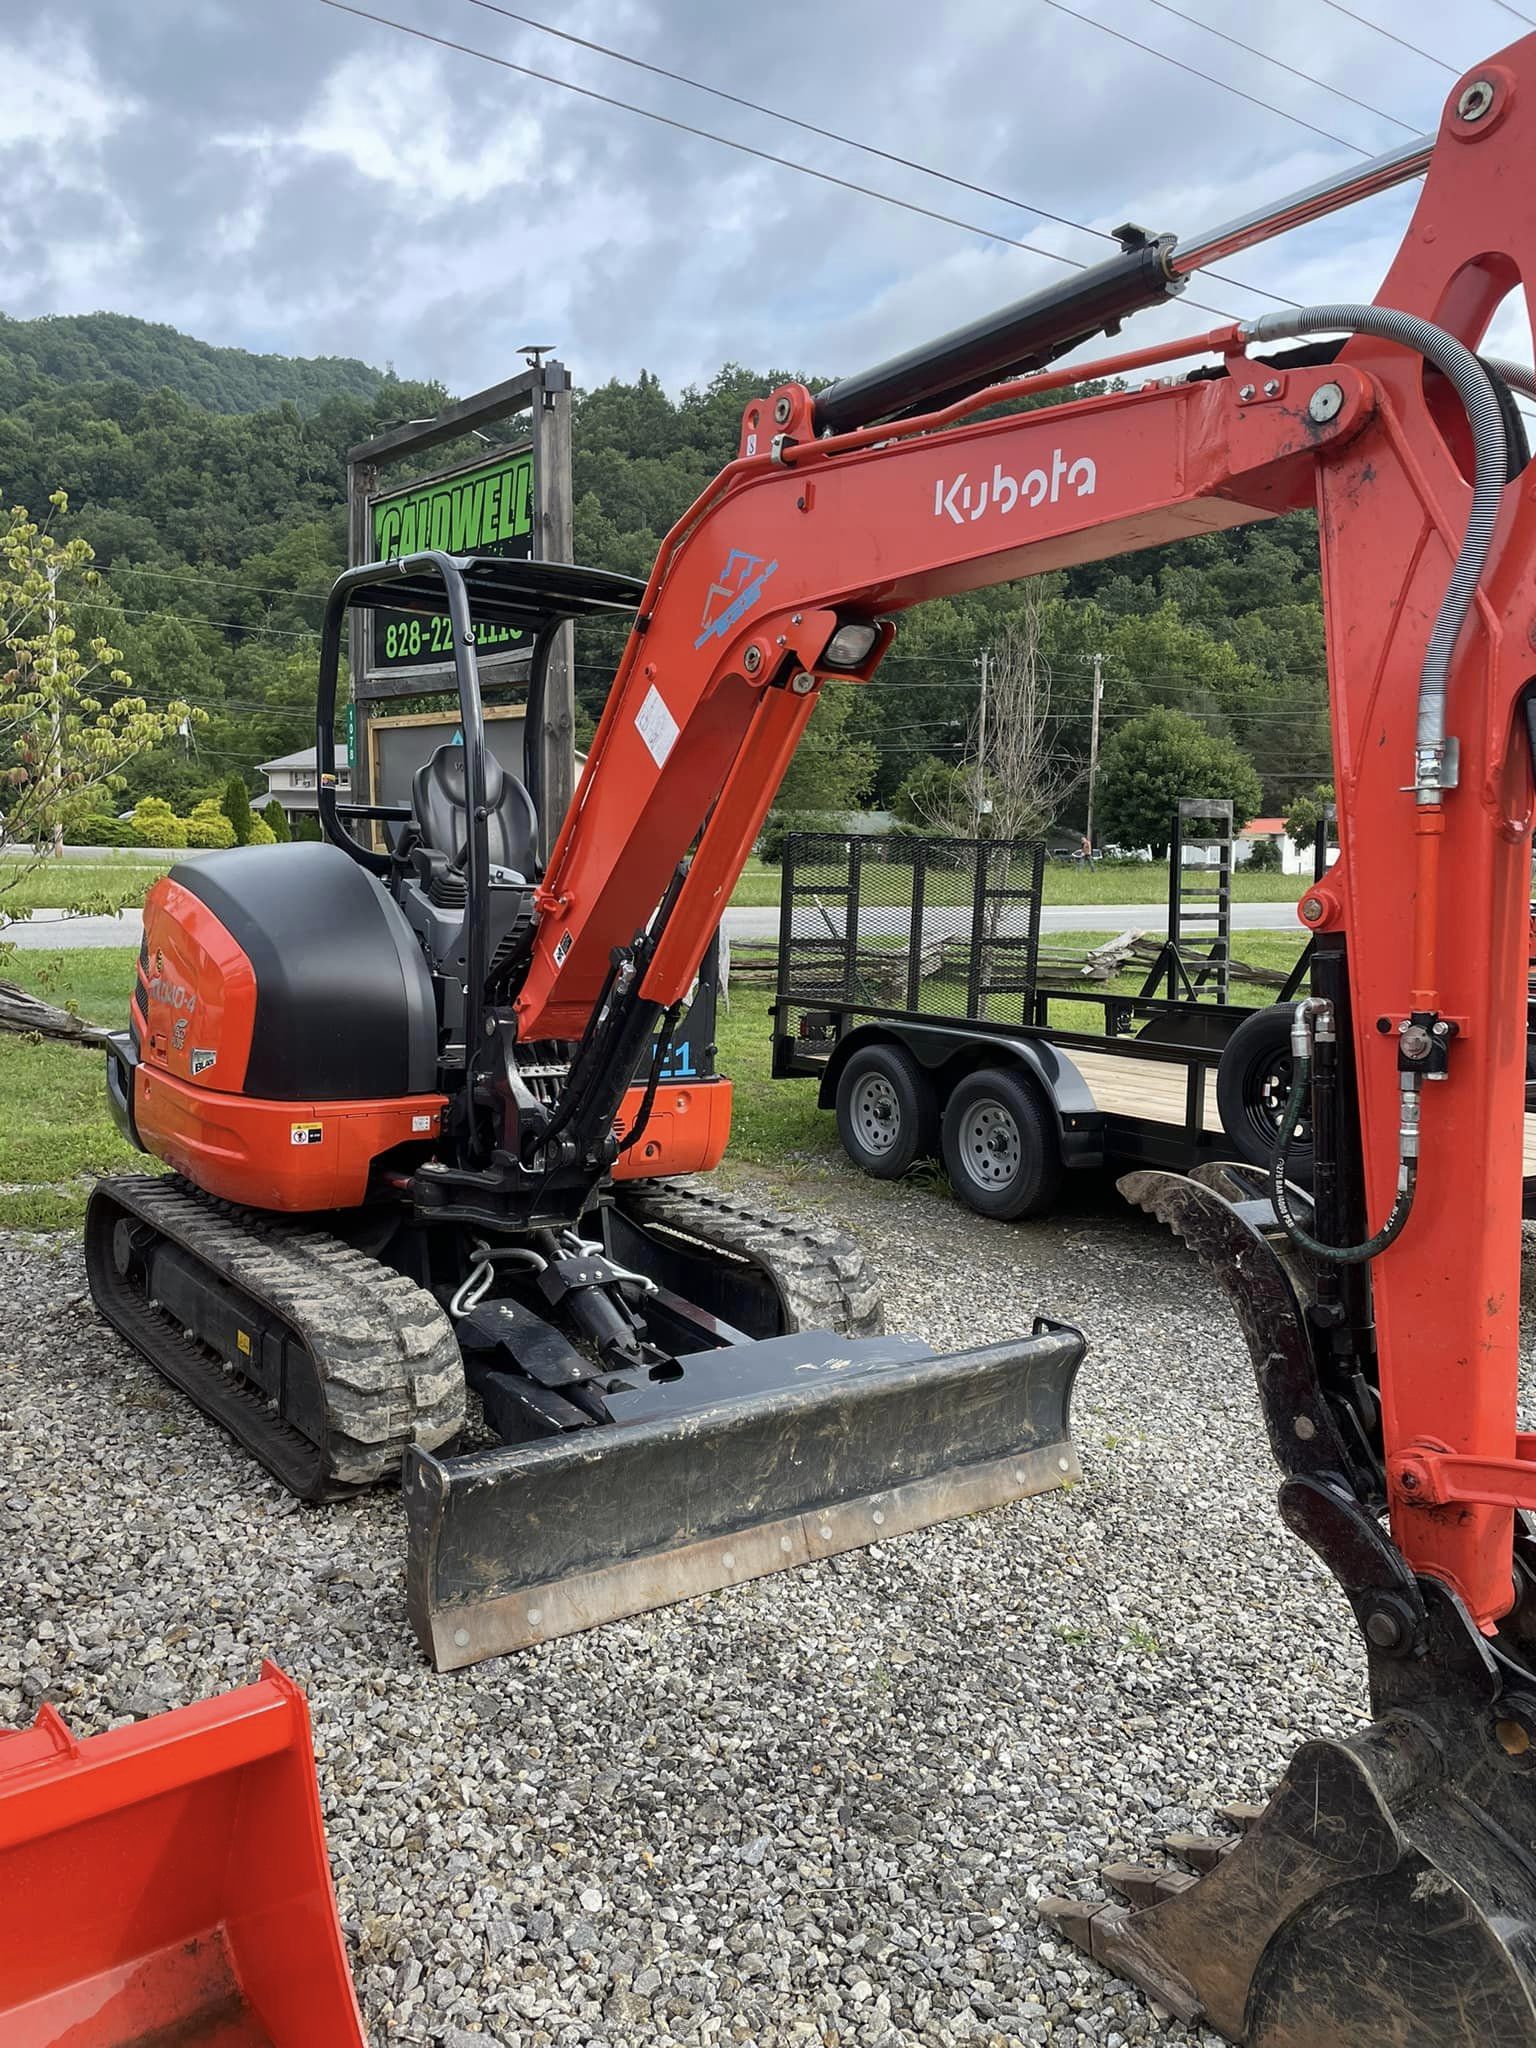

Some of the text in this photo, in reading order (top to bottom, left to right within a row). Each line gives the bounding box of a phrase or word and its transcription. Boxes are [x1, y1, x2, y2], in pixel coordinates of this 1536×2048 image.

[381, 464, 531, 561] CALDWELL
[934, 448, 1097, 525] Kubota
[386, 616, 523, 659] 828-2211
